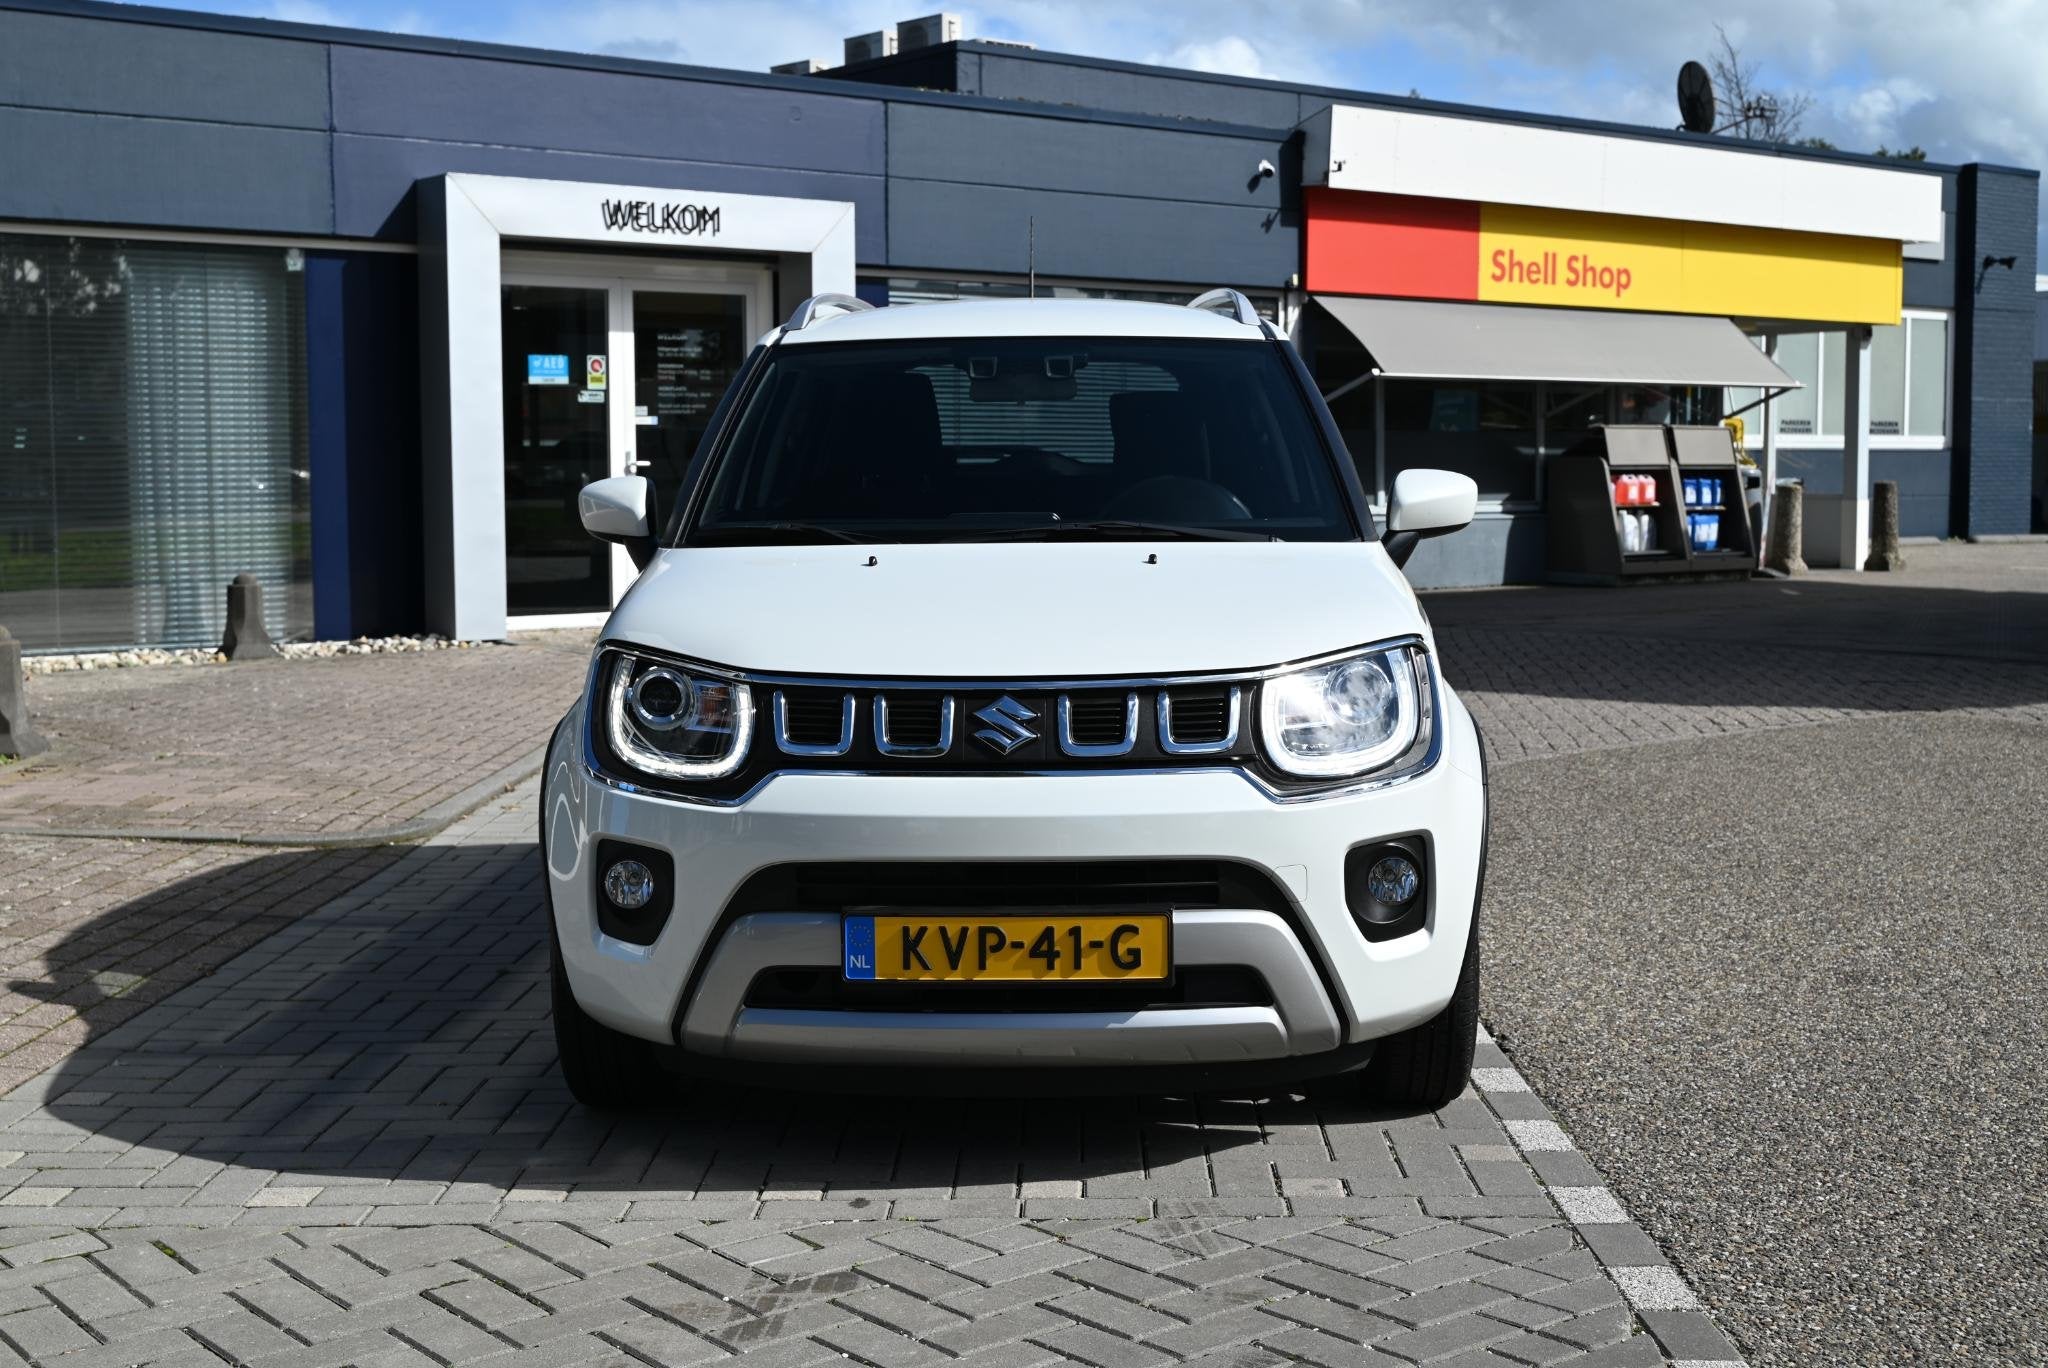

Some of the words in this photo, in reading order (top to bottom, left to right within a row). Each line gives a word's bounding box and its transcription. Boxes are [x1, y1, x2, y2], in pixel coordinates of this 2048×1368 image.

[601, 199, 720, 236] WELKOM
[1491, 249, 1556, 285] Shell
[1566, 254, 1631, 298] Shop
[850, 955, 870, 969] NL
[902, 924, 1142, 971] KVP-41-G
